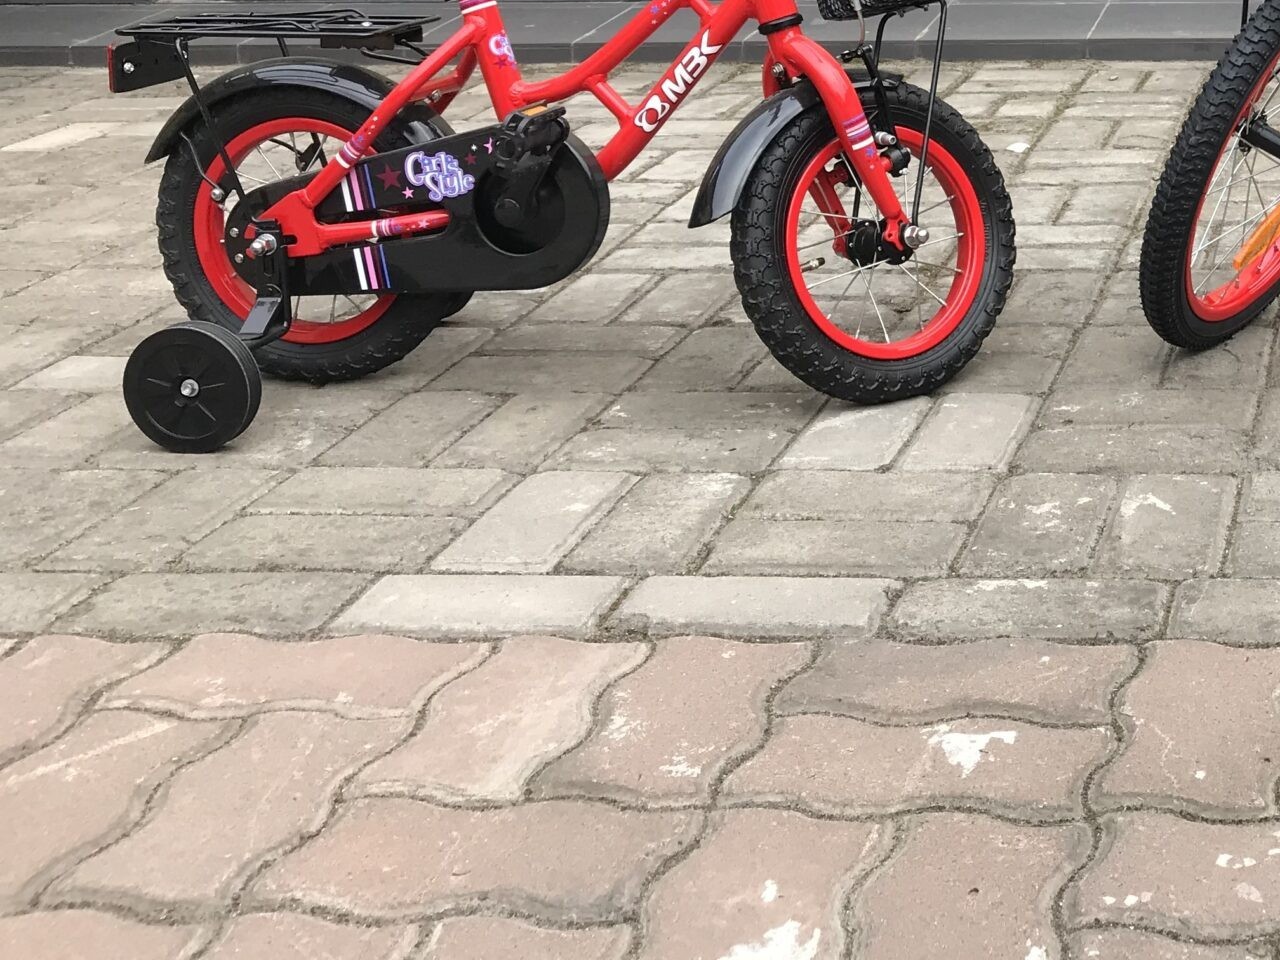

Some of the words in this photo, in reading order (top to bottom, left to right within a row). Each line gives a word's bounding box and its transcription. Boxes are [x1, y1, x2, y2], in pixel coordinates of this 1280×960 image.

[660, 28, 723, 104] MBK
[404, 151, 459, 187] Girl's
[424, 167, 476, 202] Style
